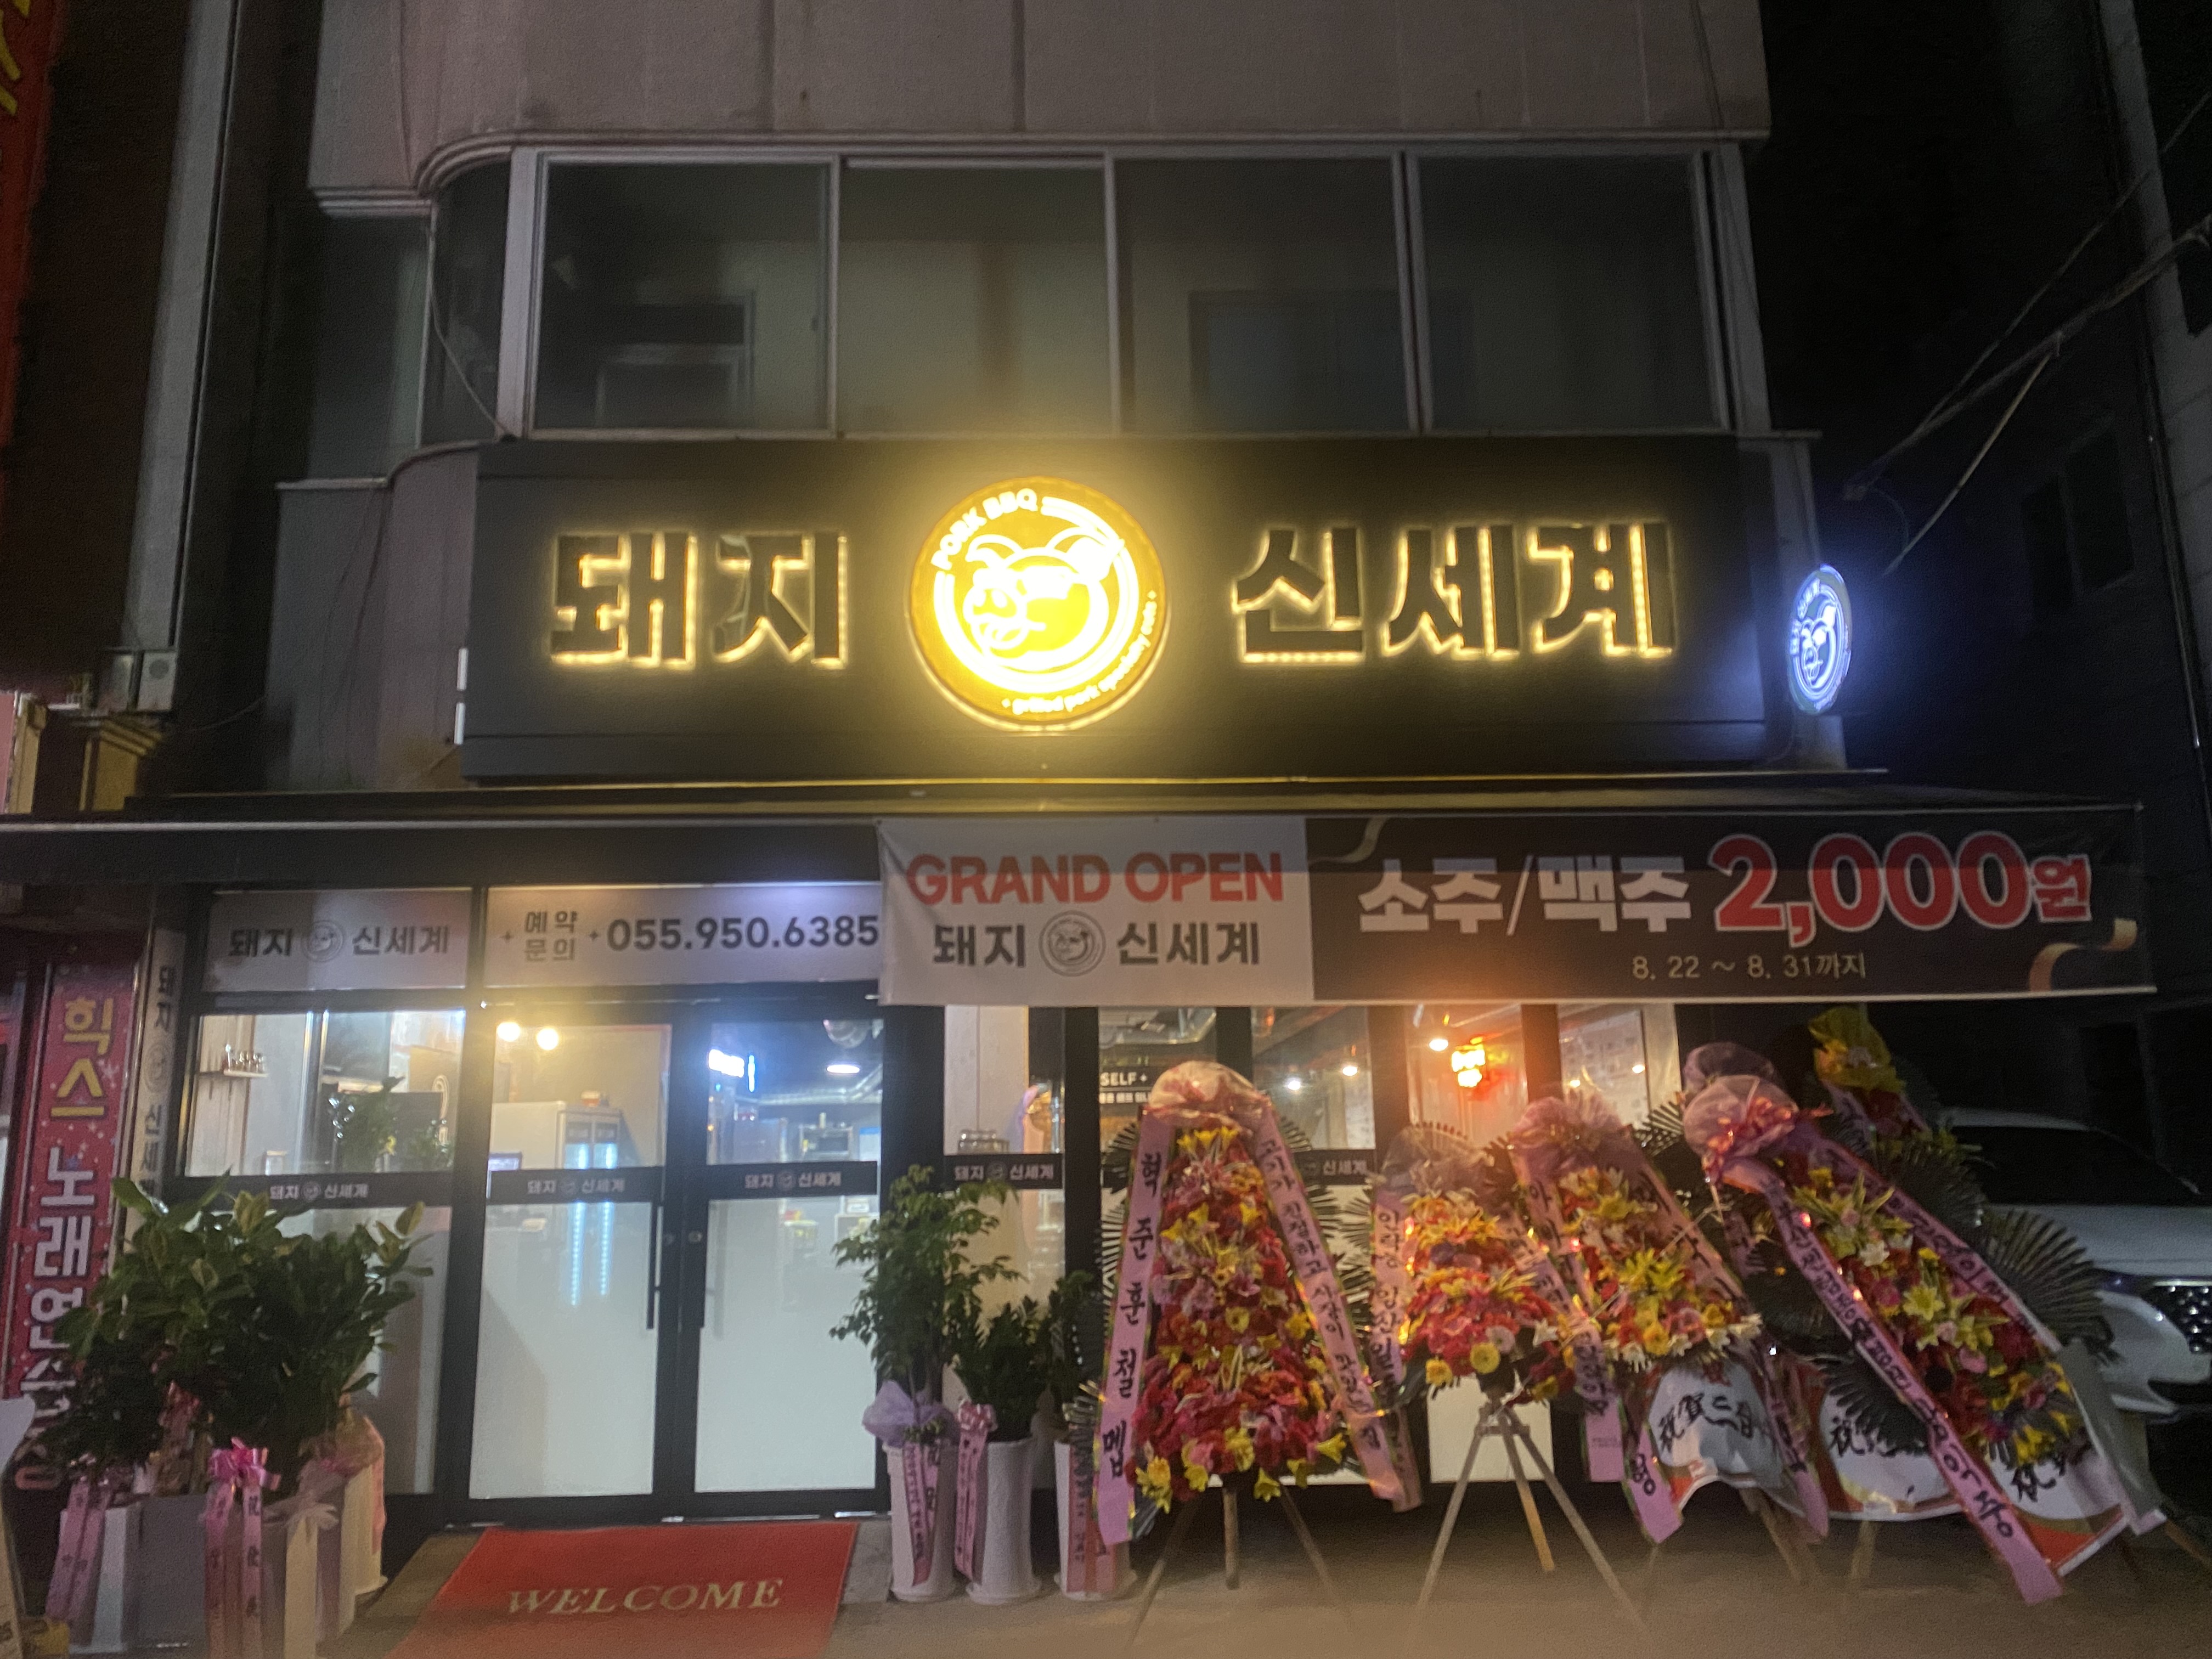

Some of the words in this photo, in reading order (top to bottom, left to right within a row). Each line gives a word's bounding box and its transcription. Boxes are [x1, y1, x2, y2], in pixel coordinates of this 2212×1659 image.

[931, 507, 986, 571] PORK
[983, 488, 1038, 520] BBQ
[550, 532, 848, 669] 돼지
[1231, 520, 1677, 661] 신세계
[906, 854, 1110, 905] GRAND
[1125, 852, 1283, 902] OPEN
[1358, 854, 1692, 935] 소주/맥주
[1707, 831, 2092, 948] 2,000원
[524, 910, 578, 933] 예약
[607, 915, 878, 950] 055.950.6385
[228, 928, 293, 957] 돼지
[352, 926, 448, 955] 신세계
[524, 938, 575, 962] 문의
[933, 924, 1026, 967] 돼지
[1116, 922, 1260, 965] 신세계
[1100, 1071, 1137, 1086] SELF
[509, 1578, 783, 1614] WELCOME
